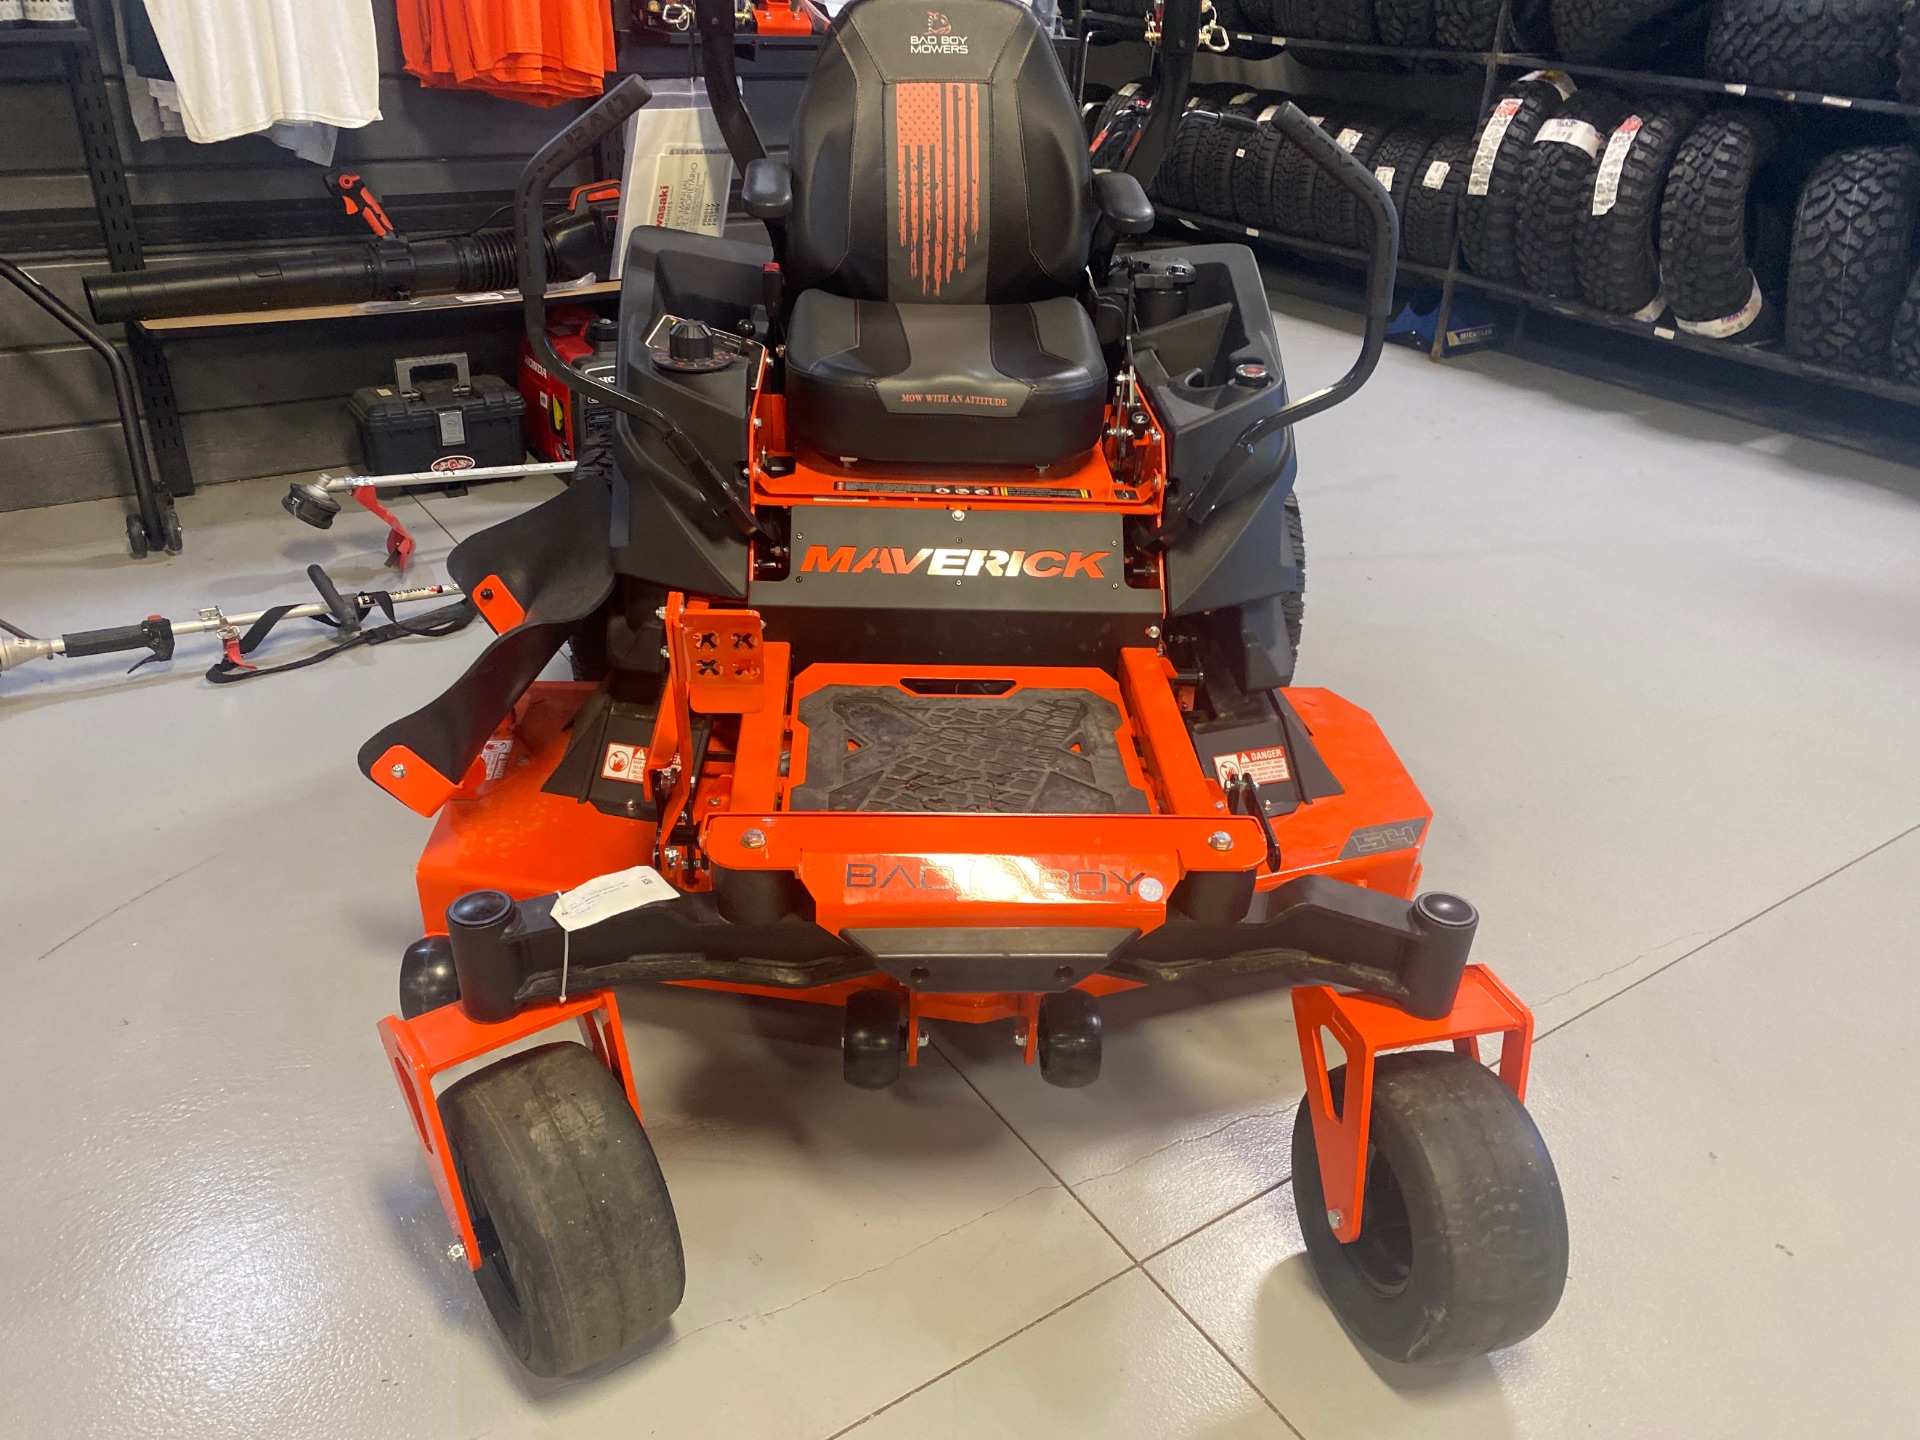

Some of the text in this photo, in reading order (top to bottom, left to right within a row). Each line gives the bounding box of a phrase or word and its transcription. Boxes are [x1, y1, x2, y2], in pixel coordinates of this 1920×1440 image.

[910, 35, 968, 45] BAD BOY
[910, 44, 969, 55] MOWERS
[678, 179, 689, 213] MANUAL
[684, 162, 698, 215] PROPIETARIO
[655, 185, 670, 228] wasaki
[524, 354, 547, 379] HONDA
[901, 394, 1008, 407] MOW WITH AN ATTITUDE
[800, 545, 1111, 579] MAVERICK
[1251, 748, 1282, 760] DANGER
[1350, 826, 1417, 853] 54
[846, 863, 1146, 896] BAD BOY
